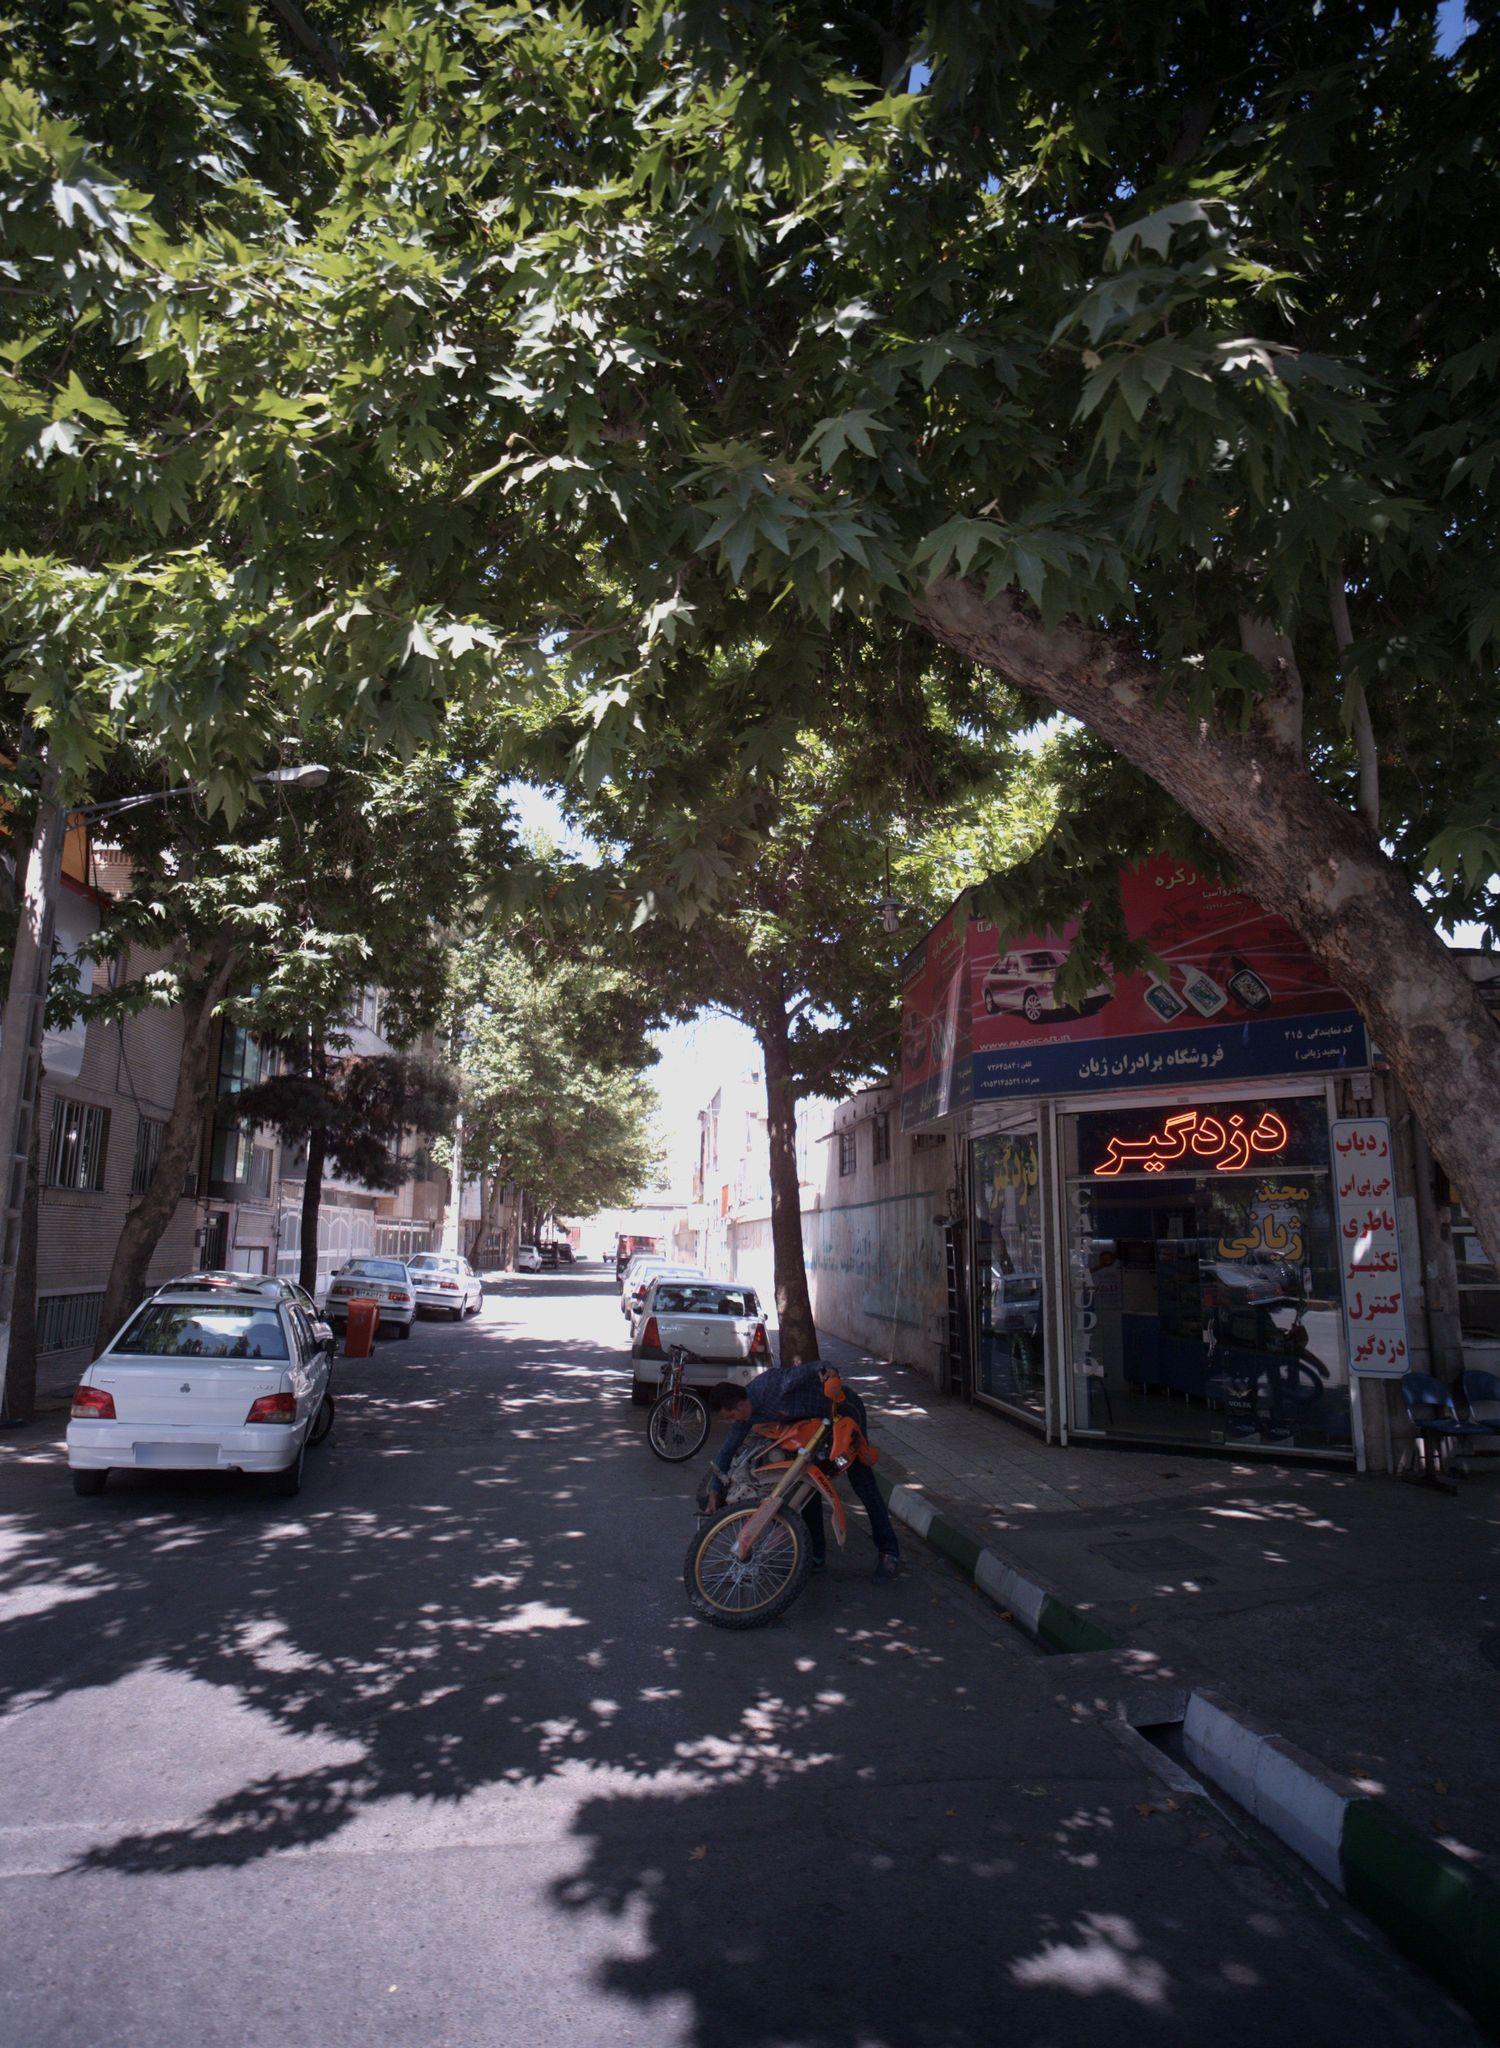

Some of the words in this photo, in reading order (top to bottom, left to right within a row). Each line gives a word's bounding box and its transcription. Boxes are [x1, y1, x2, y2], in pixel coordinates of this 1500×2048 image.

[1155, 867, 1187, 890] کره
[1078, 1056, 1108, 1078] ژیان
[1111, 1051, 1162, 1075] برادران
[1167, 1043, 1225, 1067] فروشگاه
[1094, 1111, 1288, 1175] دزدگیر
[1336, 1131, 1388, 1157] ردیاب
[1258, 1184, 1309, 1209] مجید
[1218, 1212, 1303, 1260] ژیانی
[1343, 1210, 1395, 1239] باطری
[1347, 1252, 1398, 1279] تکثیر
[1349, 1292, 1401, 1321] کنترل
[1354, 1335, 1405, 1362] دزدگیر
